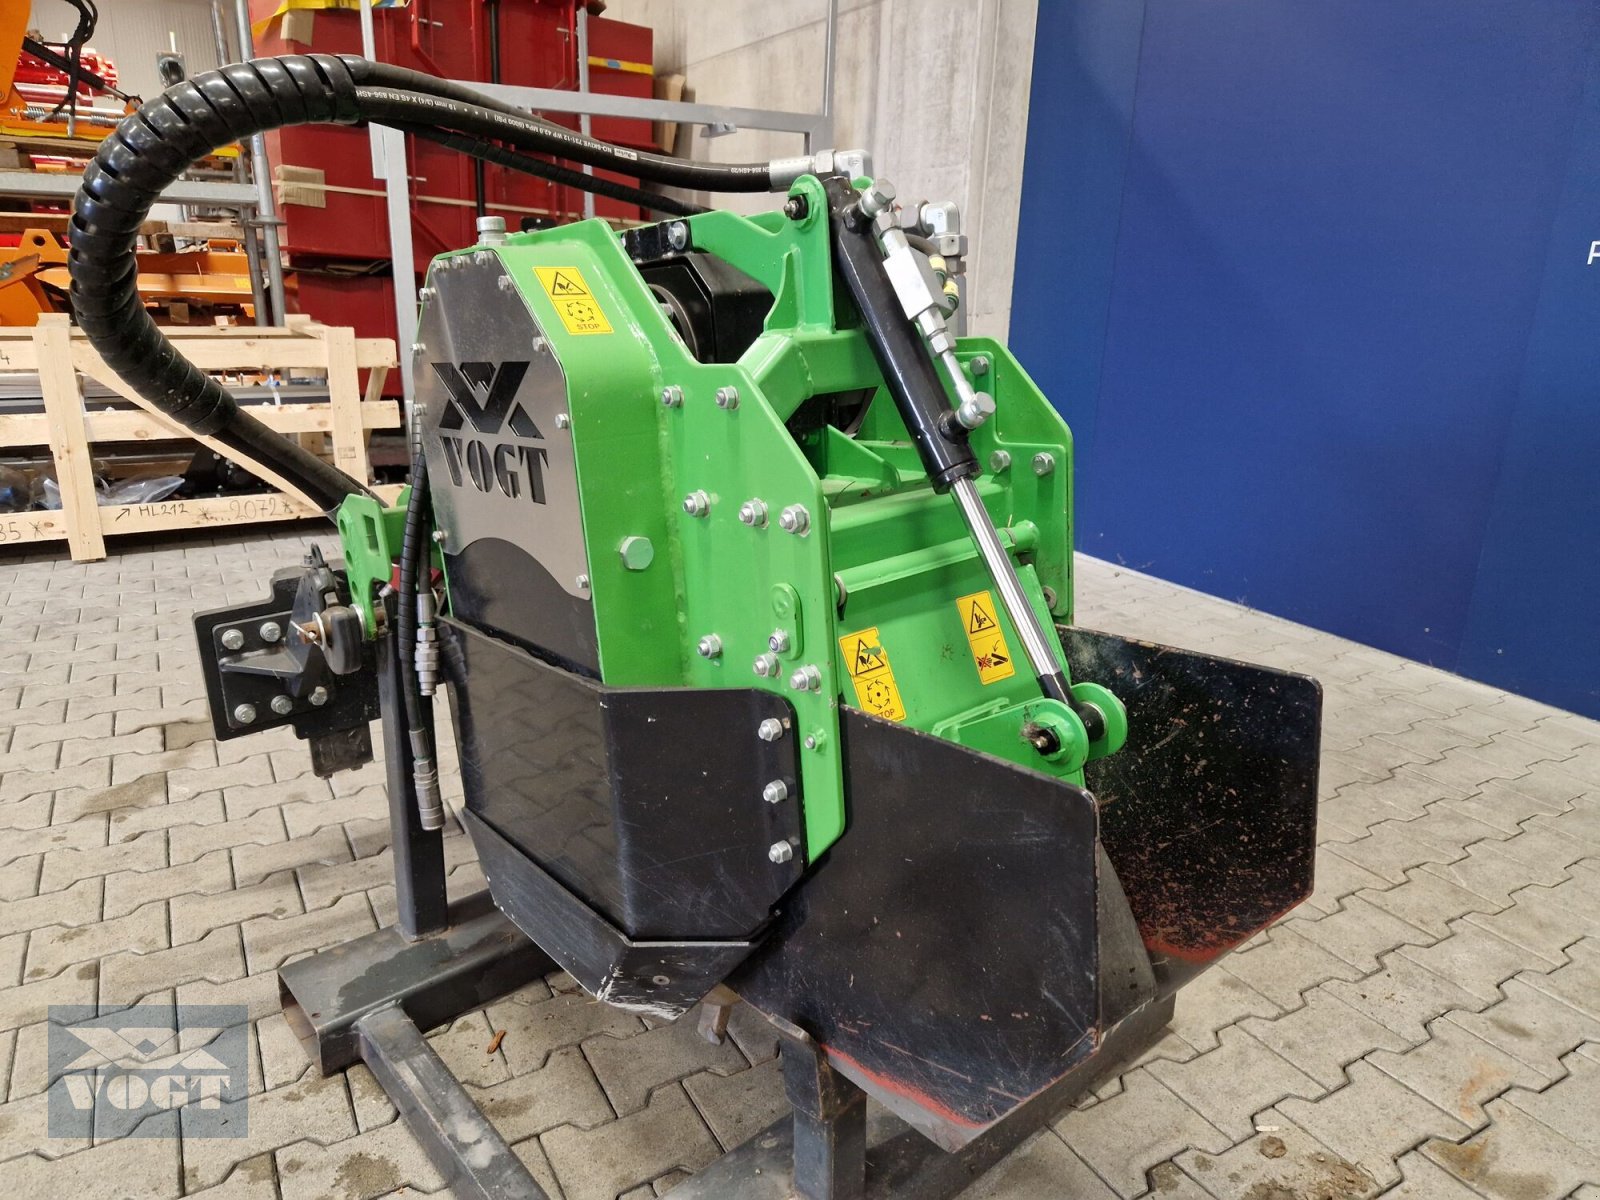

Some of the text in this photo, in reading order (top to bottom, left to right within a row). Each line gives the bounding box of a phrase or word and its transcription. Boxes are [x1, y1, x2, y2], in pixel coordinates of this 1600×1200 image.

[525, 123, 539, 132] MPa
[576, 322, 600, 331] STOP
[439, 435, 550, 505] VOGT
[138, 502, 188, 517] HL212
